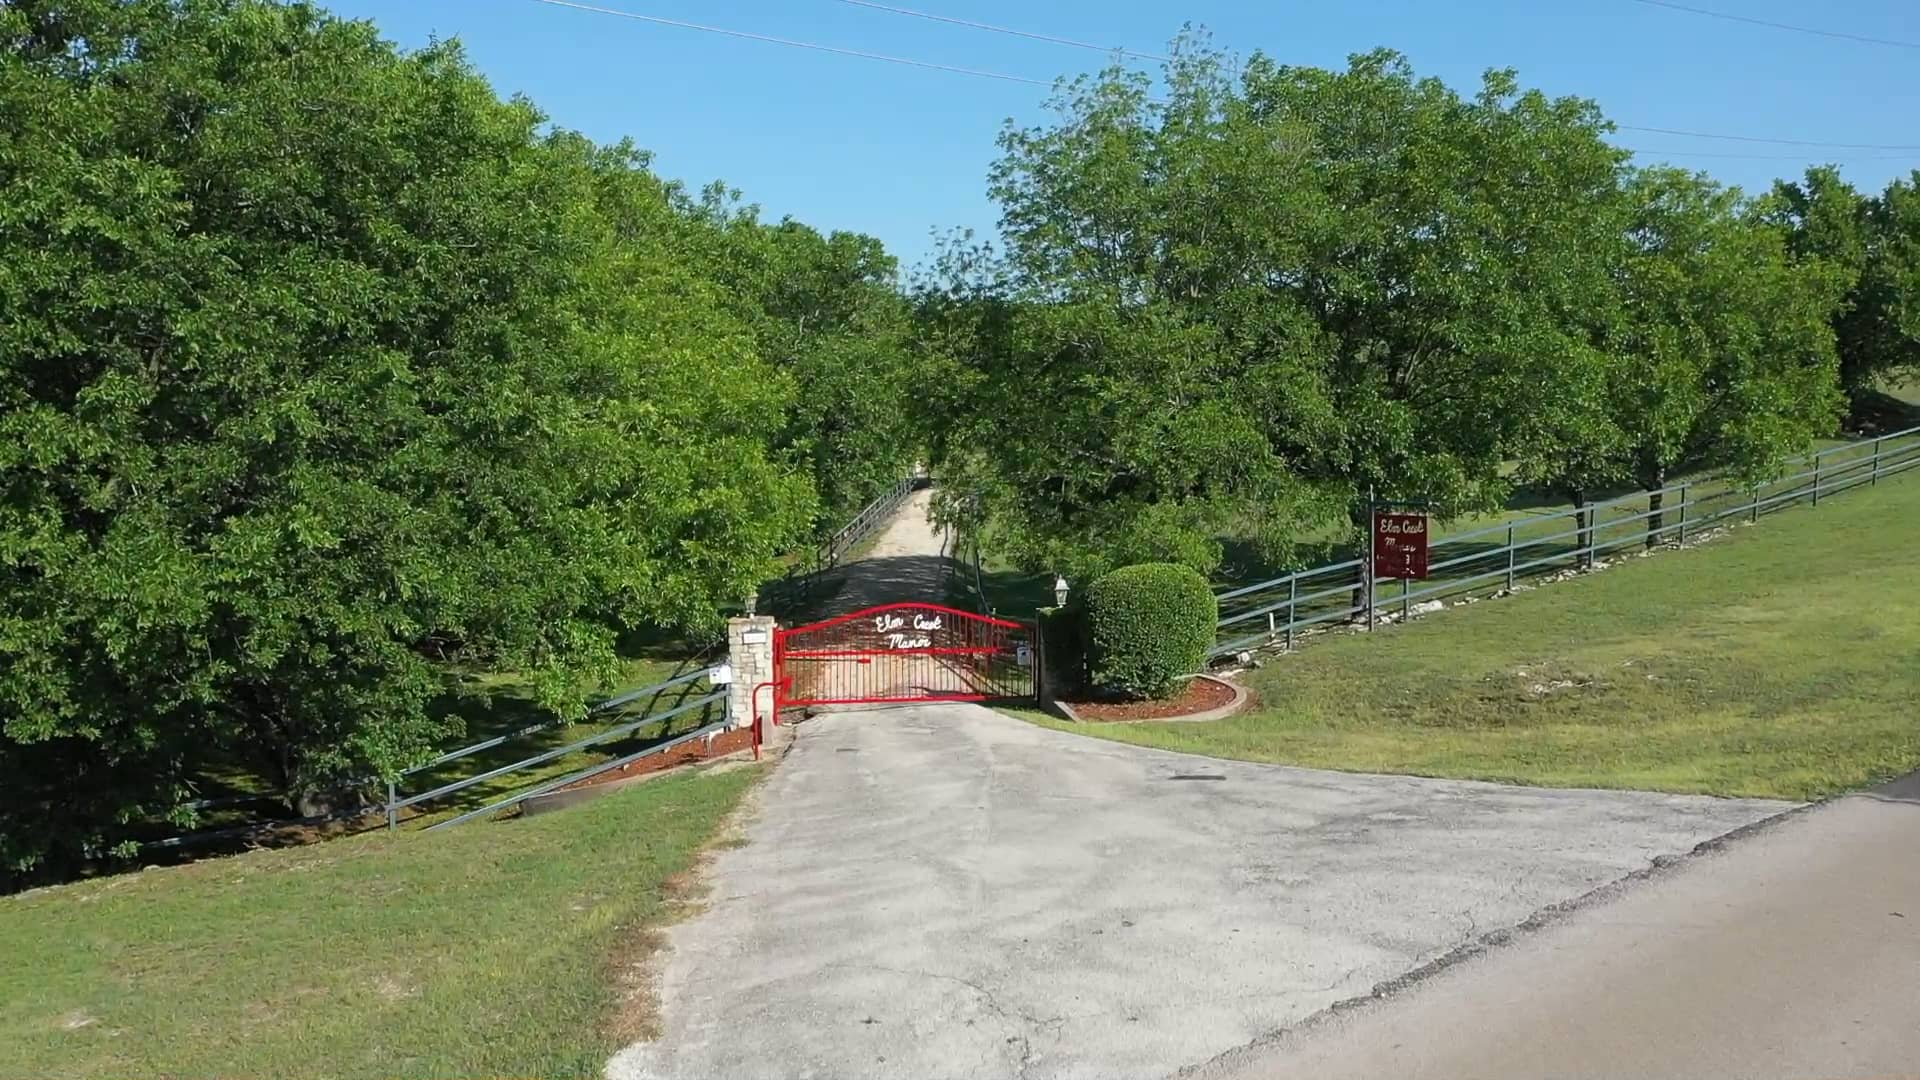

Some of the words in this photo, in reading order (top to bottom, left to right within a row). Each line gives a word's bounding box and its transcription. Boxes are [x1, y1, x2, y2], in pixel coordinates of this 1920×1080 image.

[1380, 519, 1401, 534] Elm
[876, 614, 904, 632] Elm
[888, 633, 931, 649] Manor
